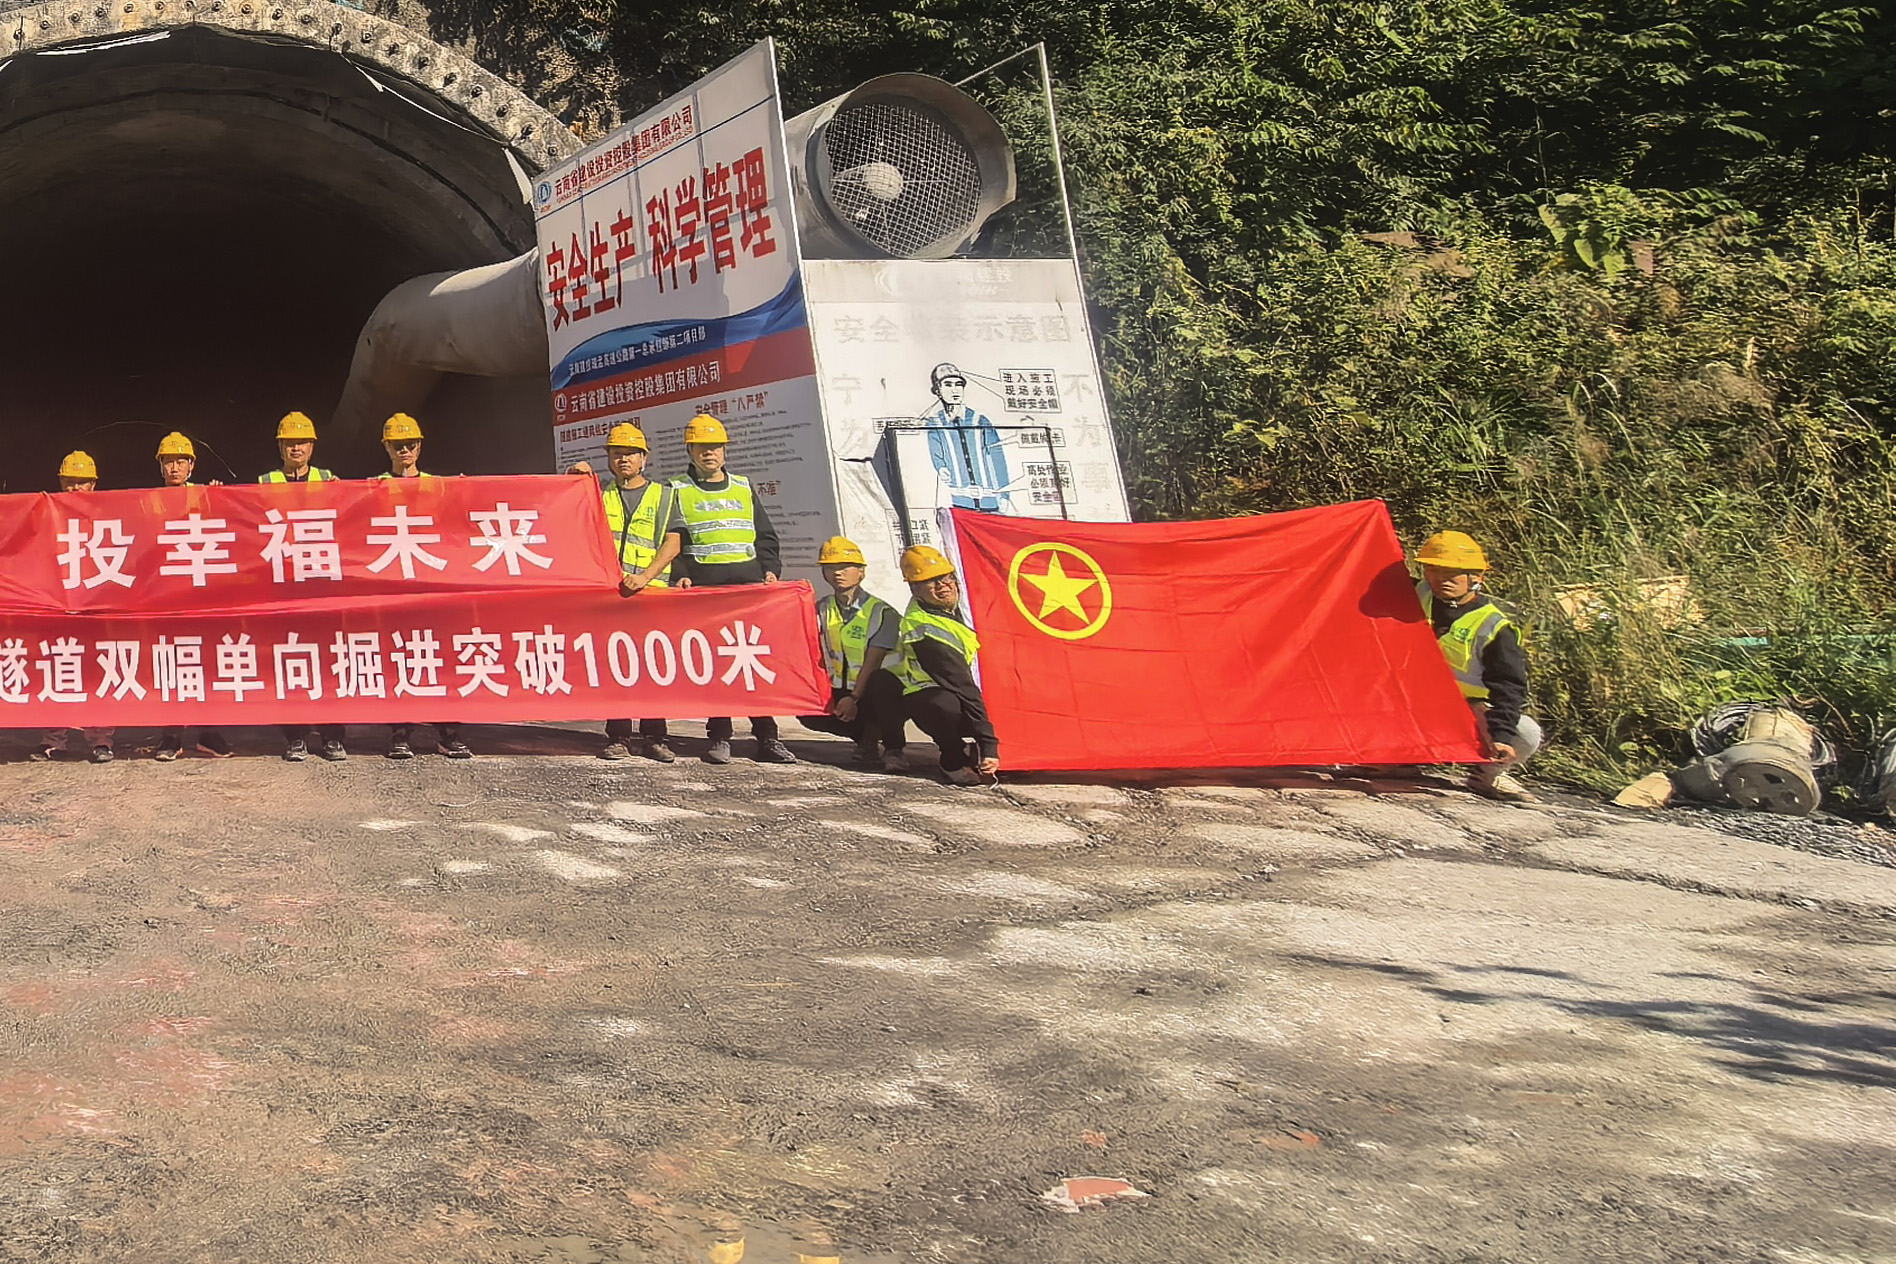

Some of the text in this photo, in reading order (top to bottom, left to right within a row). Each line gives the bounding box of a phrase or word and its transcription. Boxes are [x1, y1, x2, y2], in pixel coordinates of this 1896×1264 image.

[547, 208, 636, 332] 安全生产
[646, 147, 776, 294] 科学管理
[570, 360, 721, 414] 云南省建设投资控股集团有限公司
[56, 501, 555, 590] 投幸福未来
